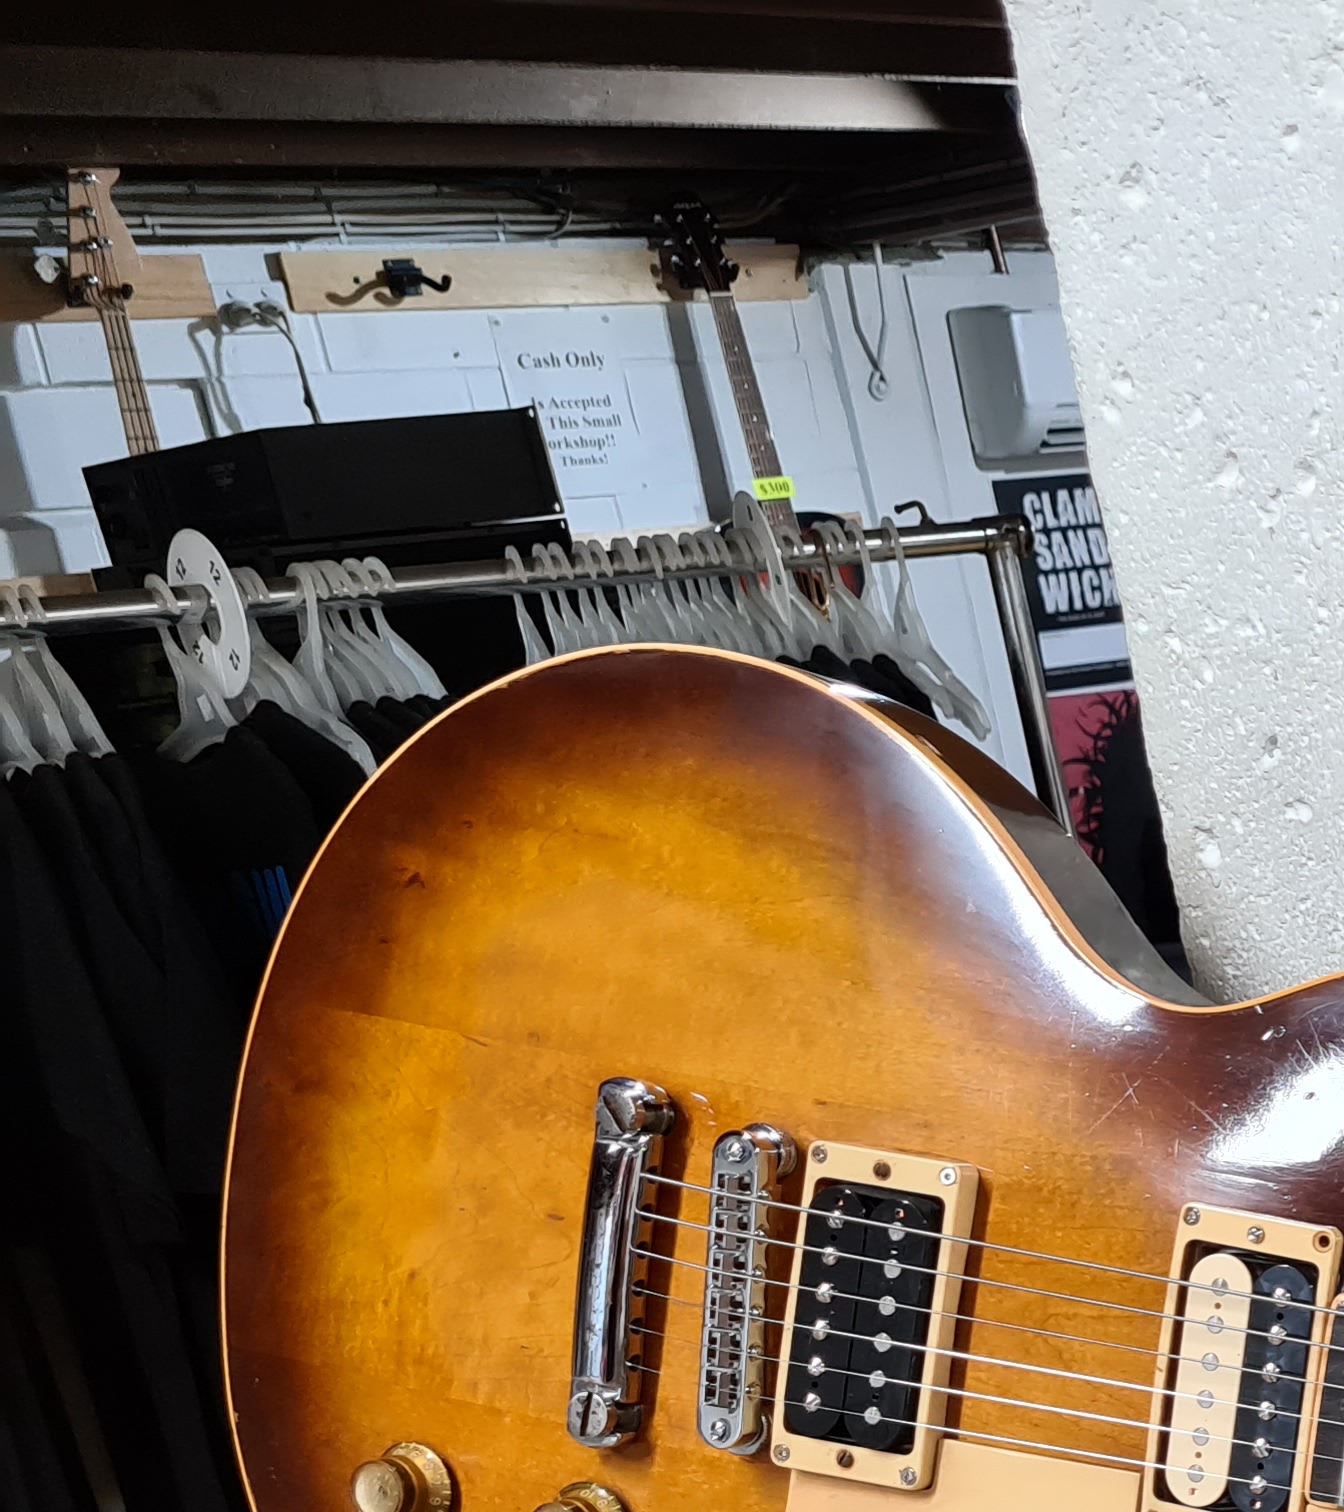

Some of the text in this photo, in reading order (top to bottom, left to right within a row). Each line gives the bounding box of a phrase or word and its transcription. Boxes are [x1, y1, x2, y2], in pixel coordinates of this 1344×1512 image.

[517, 350, 604, 371] Cash Only
[549, 394, 611, 411] Accepted
[547, 414, 621, 430] This Small
[548, 433, 616, 450] orkshop!!
[560, 453, 608, 467] Thanks!
[1022, 486, 1100, 531] CLAM
[1034, 527, 1111, 571] SAND
[209, 560, 221, 586] 12
